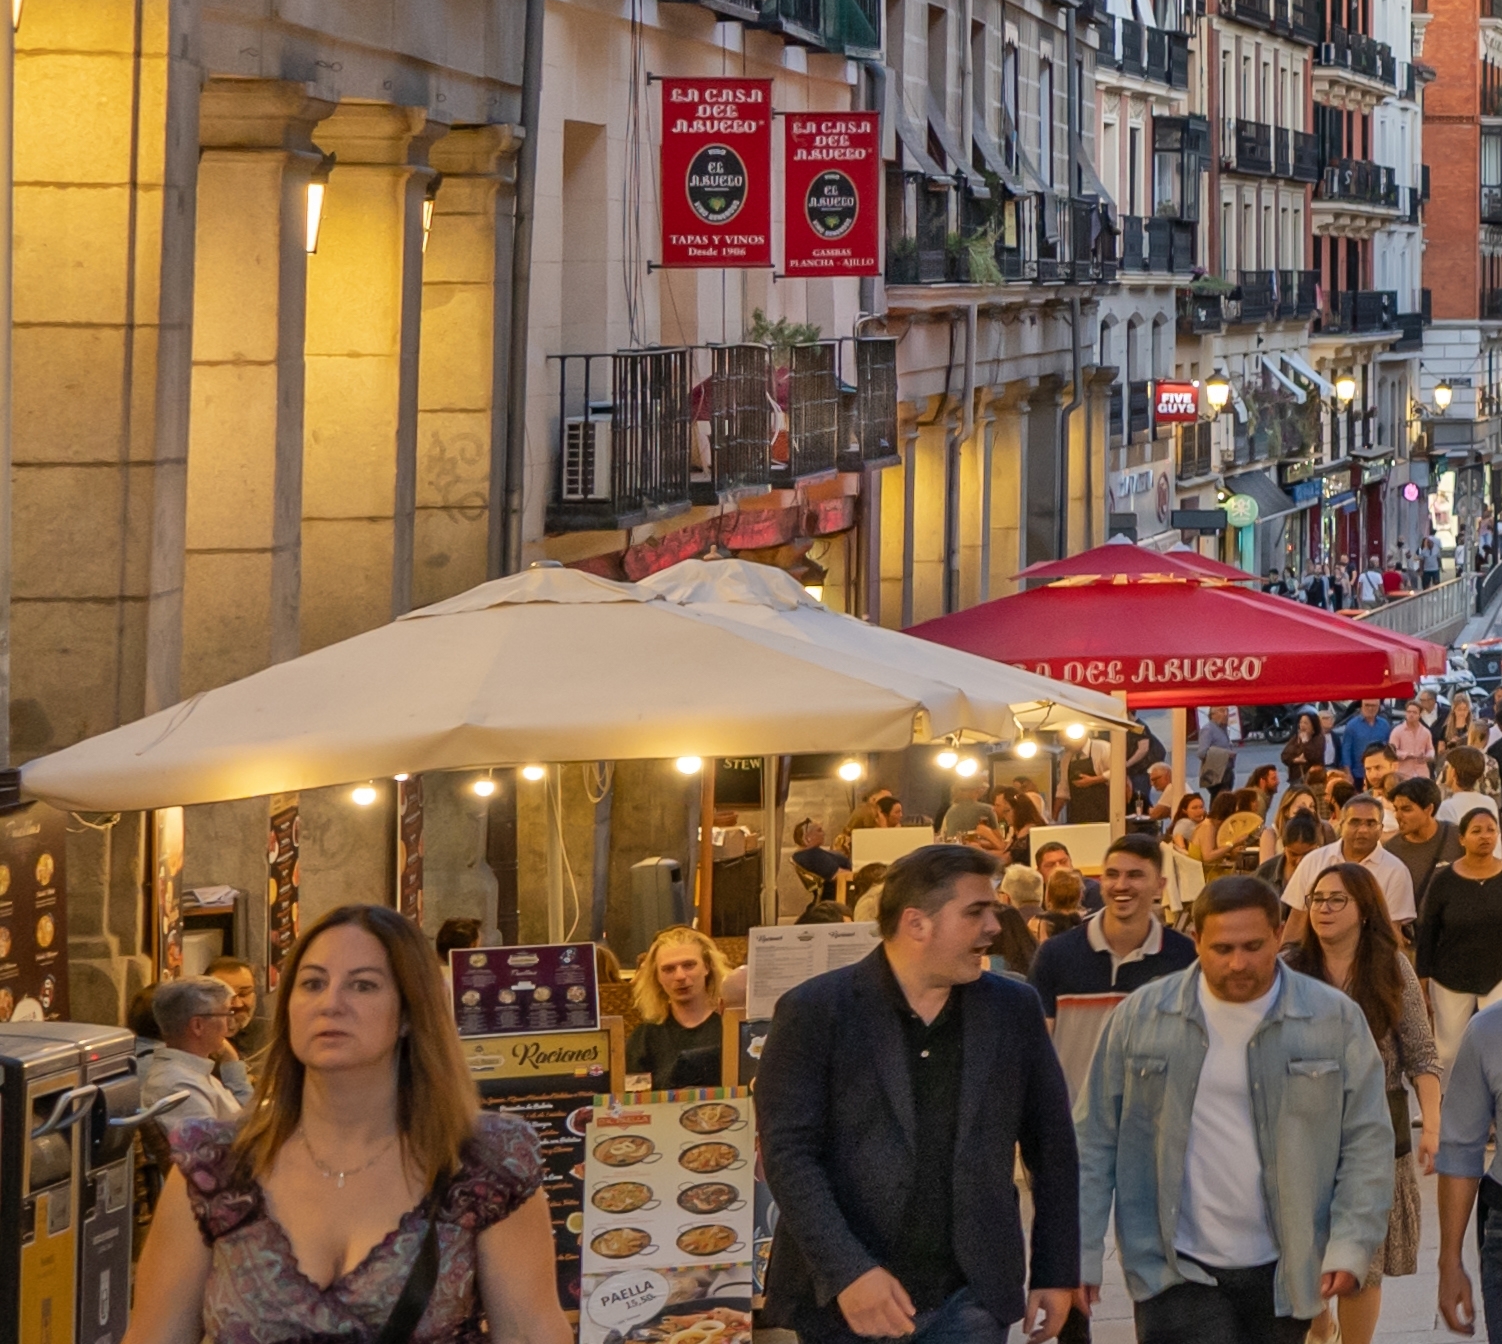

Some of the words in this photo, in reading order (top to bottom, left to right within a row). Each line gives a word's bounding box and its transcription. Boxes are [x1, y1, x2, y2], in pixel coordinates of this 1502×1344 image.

[696, 104, 738, 118] DEL
[670, 235, 708, 244] TAPAS
[713, 235, 722, 244] Y
[725, 235, 764, 244] VINOS
[688, 247, 717, 256] Desde
[1161, 393, 1192, 404] FIVE
[1157, 403, 1195, 414] GUYS
[1063, 660, 1125, 684] DEL
[1131, 657, 1262, 683] ABUELO
[723, 758, 760, 770] STEW
[512, 1042, 600, 1069] Raciones
[600, 1280, 654, 1307] PAELLA
